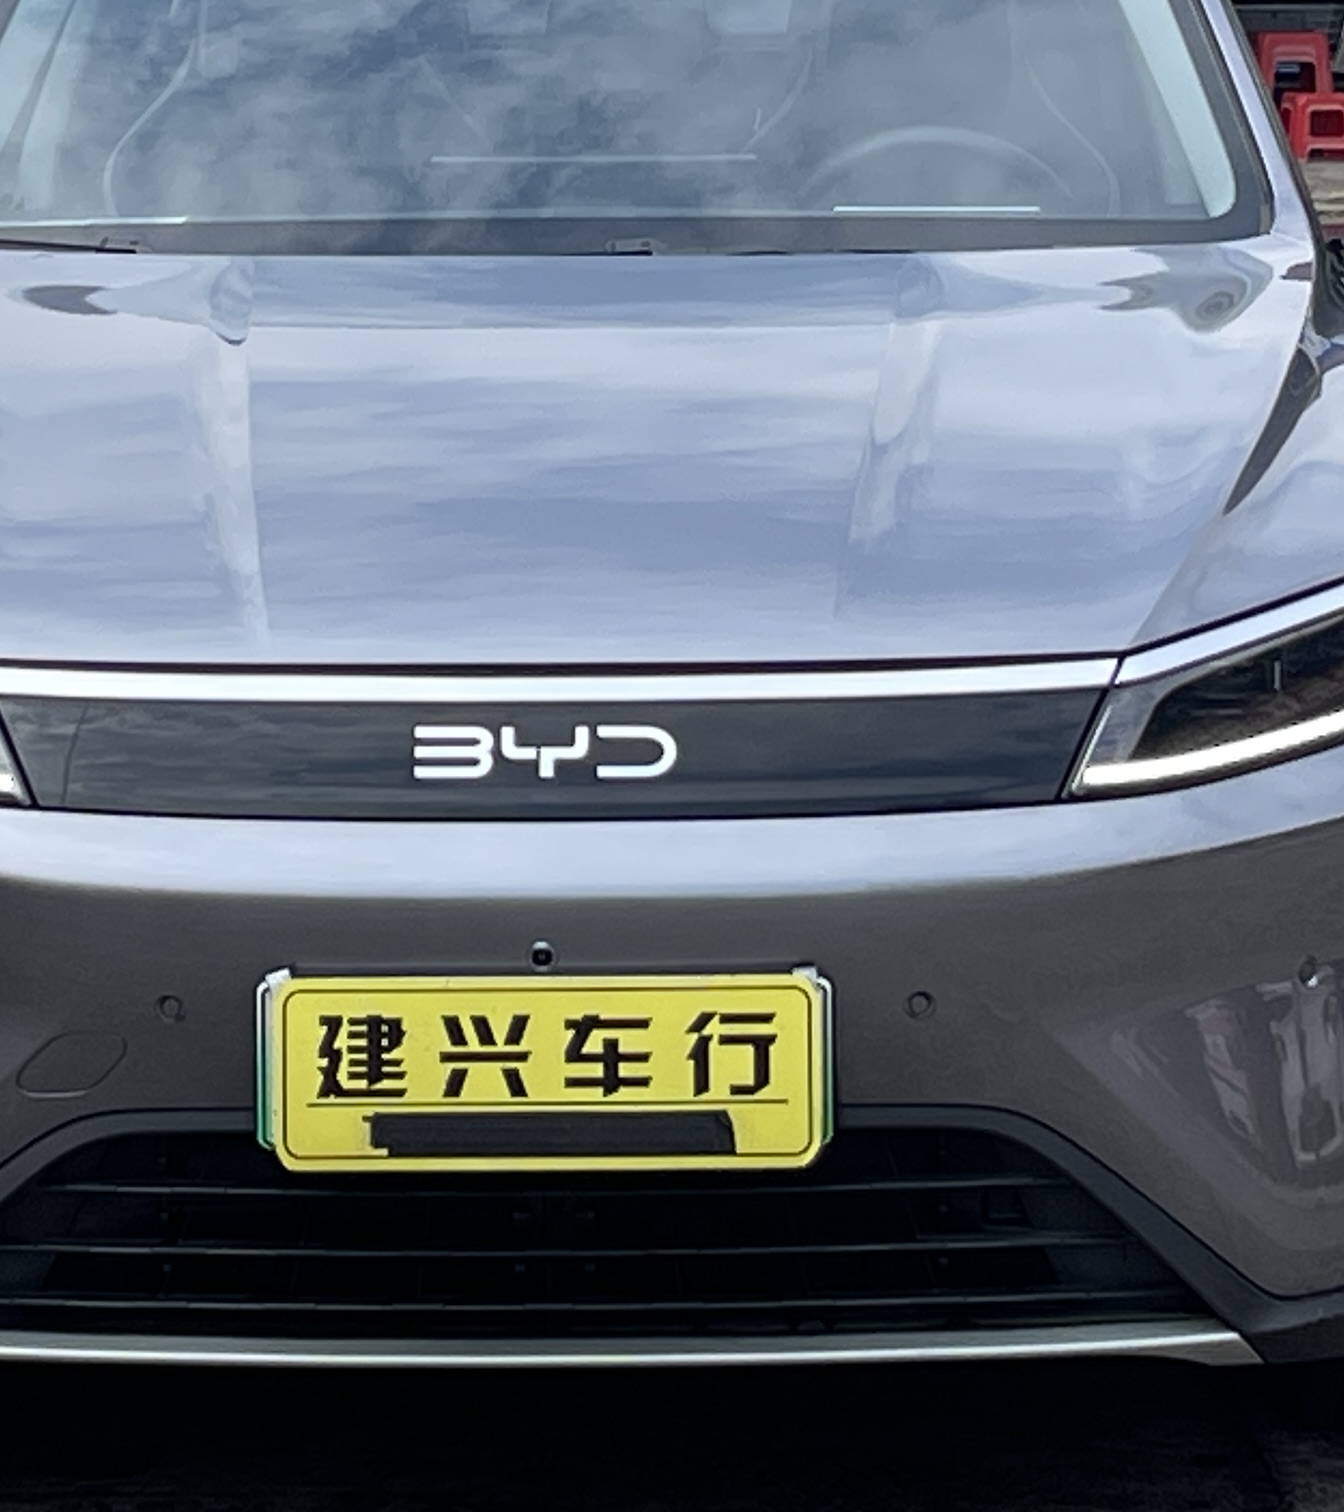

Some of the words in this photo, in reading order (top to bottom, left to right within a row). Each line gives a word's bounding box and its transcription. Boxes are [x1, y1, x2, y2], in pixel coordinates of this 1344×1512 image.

[413, 724, 677, 779] BYD
[316, 1011, 778, 1100] 建兴车行
